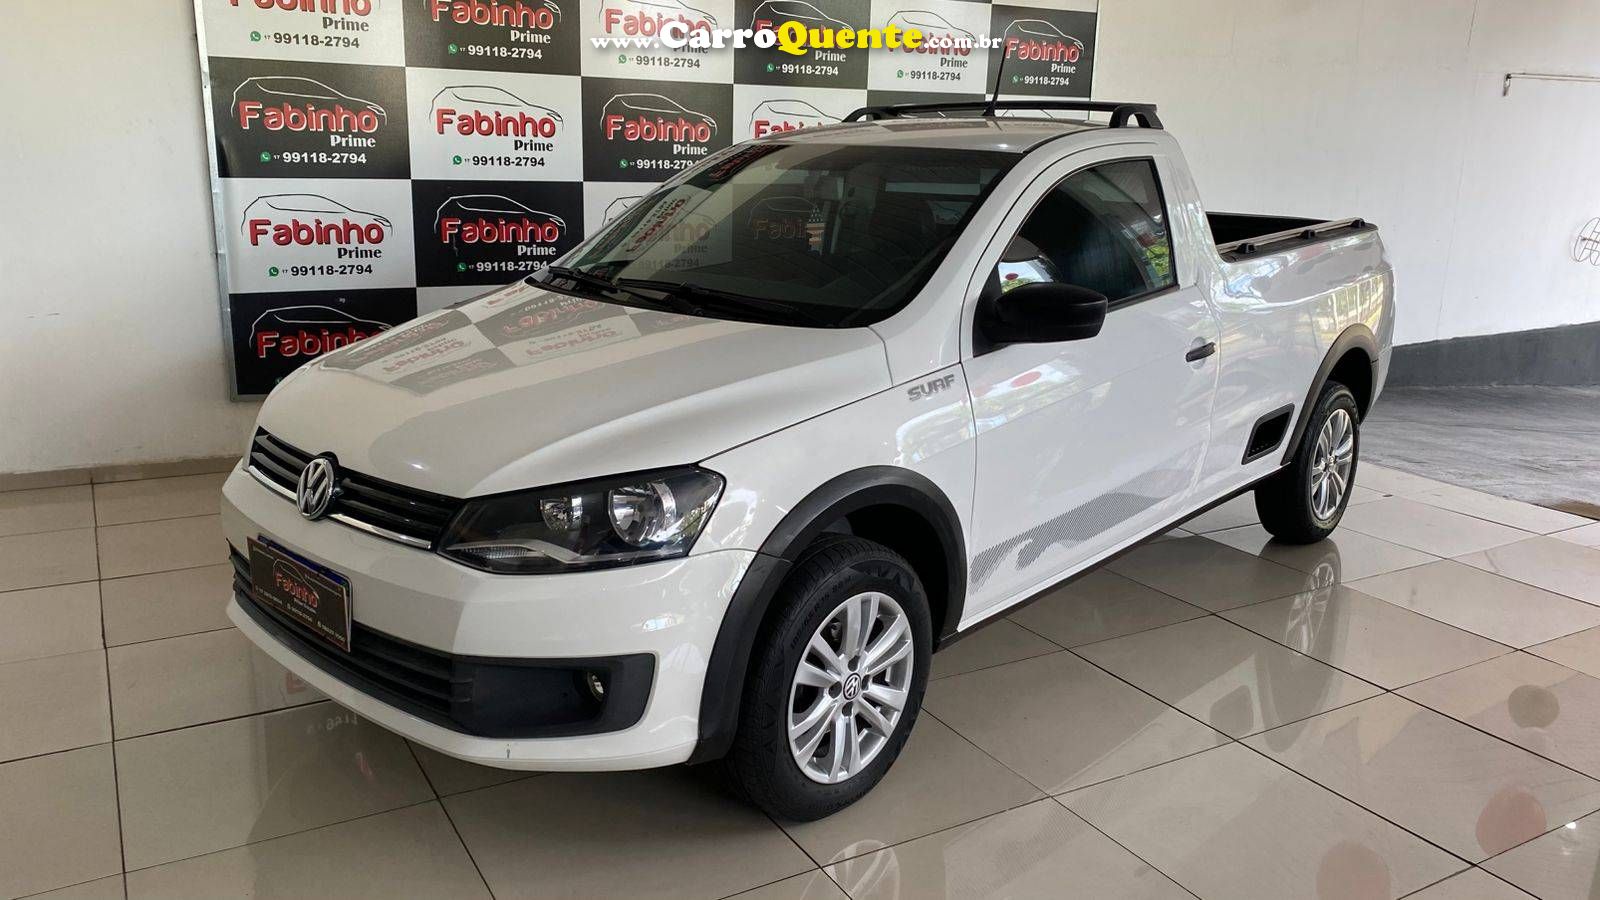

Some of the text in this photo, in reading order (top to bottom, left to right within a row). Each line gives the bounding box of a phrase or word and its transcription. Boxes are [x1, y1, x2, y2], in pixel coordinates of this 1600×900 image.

[431, 0, 554, 29] Fabinho
[322, 16, 369, 32] Prime
[605, 8, 712, 40] Fabi
[273, 32, 360, 48] 99118-2794
[510, 29, 551, 44] Prime
[467, 44, 543, 59] 99118-2794
[814, 50, 847, 62] Prime
[1005, 36, 1080, 63] Fabinho
[636, 55, 701, 69] 99118-2794
[781, 63, 839, 75] 99118-2794
[940, 57, 968, 68] Prime
[1050, 63, 1076, 74] Prime
[910, 70, 961, 81] 99118-2794
[1024, 75, 1070, 86] 99118-2794
[238, 100, 379, 134] Fabinho
[436, 108, 556, 138] Fabinho
[606, 114, 711, 143] Fabinho
[330, 134, 377, 148] Prime
[513, 139, 554, 152] Prime
[672, 143, 708, 155] Prime
[282, 151, 367, 164] 99118-2794
[472, 155, 546, 167] 99118-2794
[636, 159, 698, 169] 99118-279
[249, 218, 385, 246] Fabinho
[440, 217, 559, 244] Fabinho
[337, 246, 382, 259] Prime
[517, 244, 557, 256] Prime
[290, 264, 373, 277] 99118-2794
[476, 260, 548, 272] 99118-2794
[256, 327, 386, 359] Fabinh
[907, 373, 955, 402] SURF
